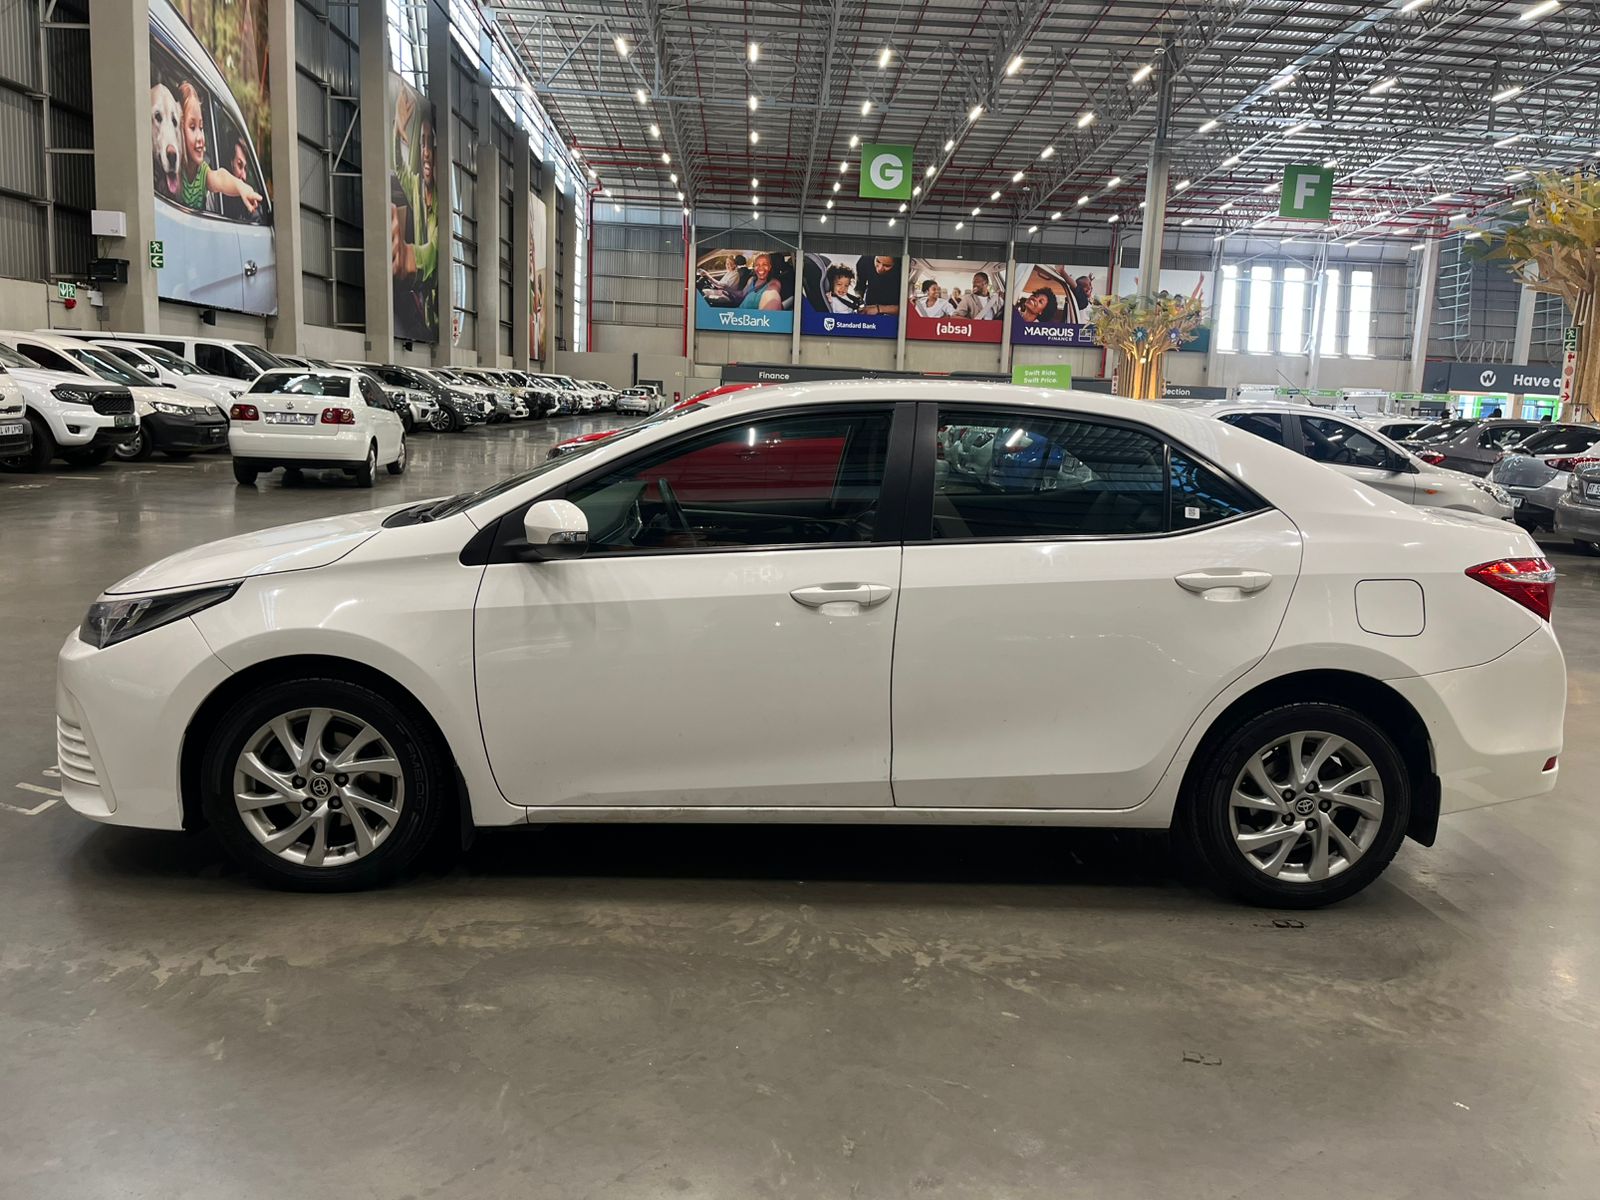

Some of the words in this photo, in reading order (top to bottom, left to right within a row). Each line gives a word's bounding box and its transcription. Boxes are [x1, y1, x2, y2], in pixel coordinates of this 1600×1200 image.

[870, 153, 904, 190] G
[1293, 174, 1321, 209] F
[719, 311, 770, 327] WesBank
[836, 321, 862, 329] Standard
[1024, 326, 1074, 337] MARQUIS
[758, 371, 790, 380] Finance
[1513, 373, 1550, 387] Have
